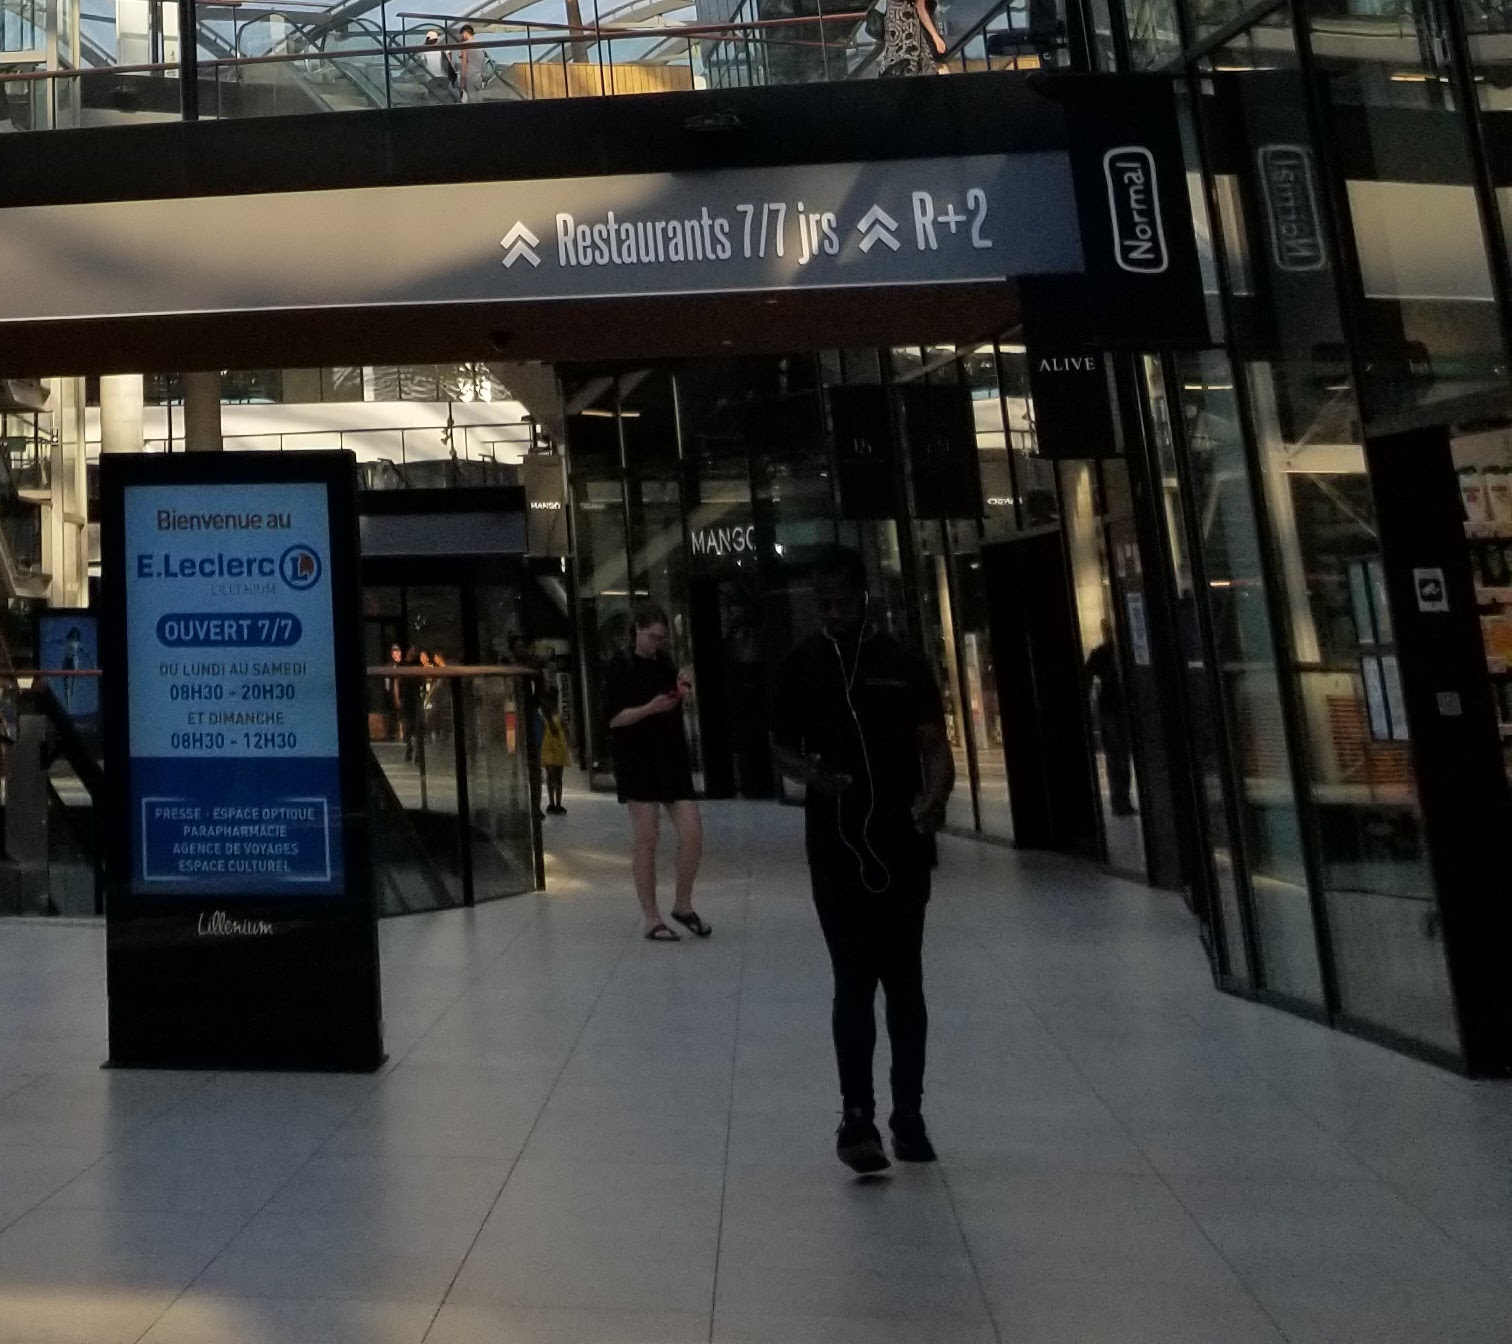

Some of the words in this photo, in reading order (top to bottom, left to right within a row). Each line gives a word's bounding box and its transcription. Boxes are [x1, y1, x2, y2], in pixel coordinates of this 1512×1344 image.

[1115, 162, 1156, 260] Normal
[556, 211, 733, 267] Restaurants
[737, 203, 787, 259] 7/7
[797, 201, 840, 265] jrs
[912, 188, 994, 251] R+2
[1039, 357, 1096, 373] ALIVE
[157, 510, 262, 531] Bienvenue
[267, 512, 292, 529] au
[138, 553, 275, 578] E.Leclerc
[164, 619, 252, 641] OUVERT
[258, 618, 293, 643] 7/7
[159, 664, 179, 677] DU
[183, 663, 225, 676] LUNDI
[229, 663, 249, 675] AU
[253, 662, 307, 675] SAMEDI
[170, 684, 223, 701] 08H30
[241, 684, 295, 700] 20H30
[188, 713, 203, 725] ET
[208, 712, 284, 725] DIMANCHE
[171, 732, 224, 749] 08H30
[244, 732, 297, 749] 12H30
[155, 808, 201, 820] PRESSE
[213, 808, 259, 820] ESPACE
[262, 807, 315, 820] OPTIQUE
[184, 825, 287, 837] PARAPHARMACIE
[173, 843, 221, 855] AGENCE
[225, 843, 240, 855] DE
[244, 842, 299, 855] VOYAGES
[179, 860, 225, 872] ESPACE
[228, 860, 291, 872] CULTUREL
